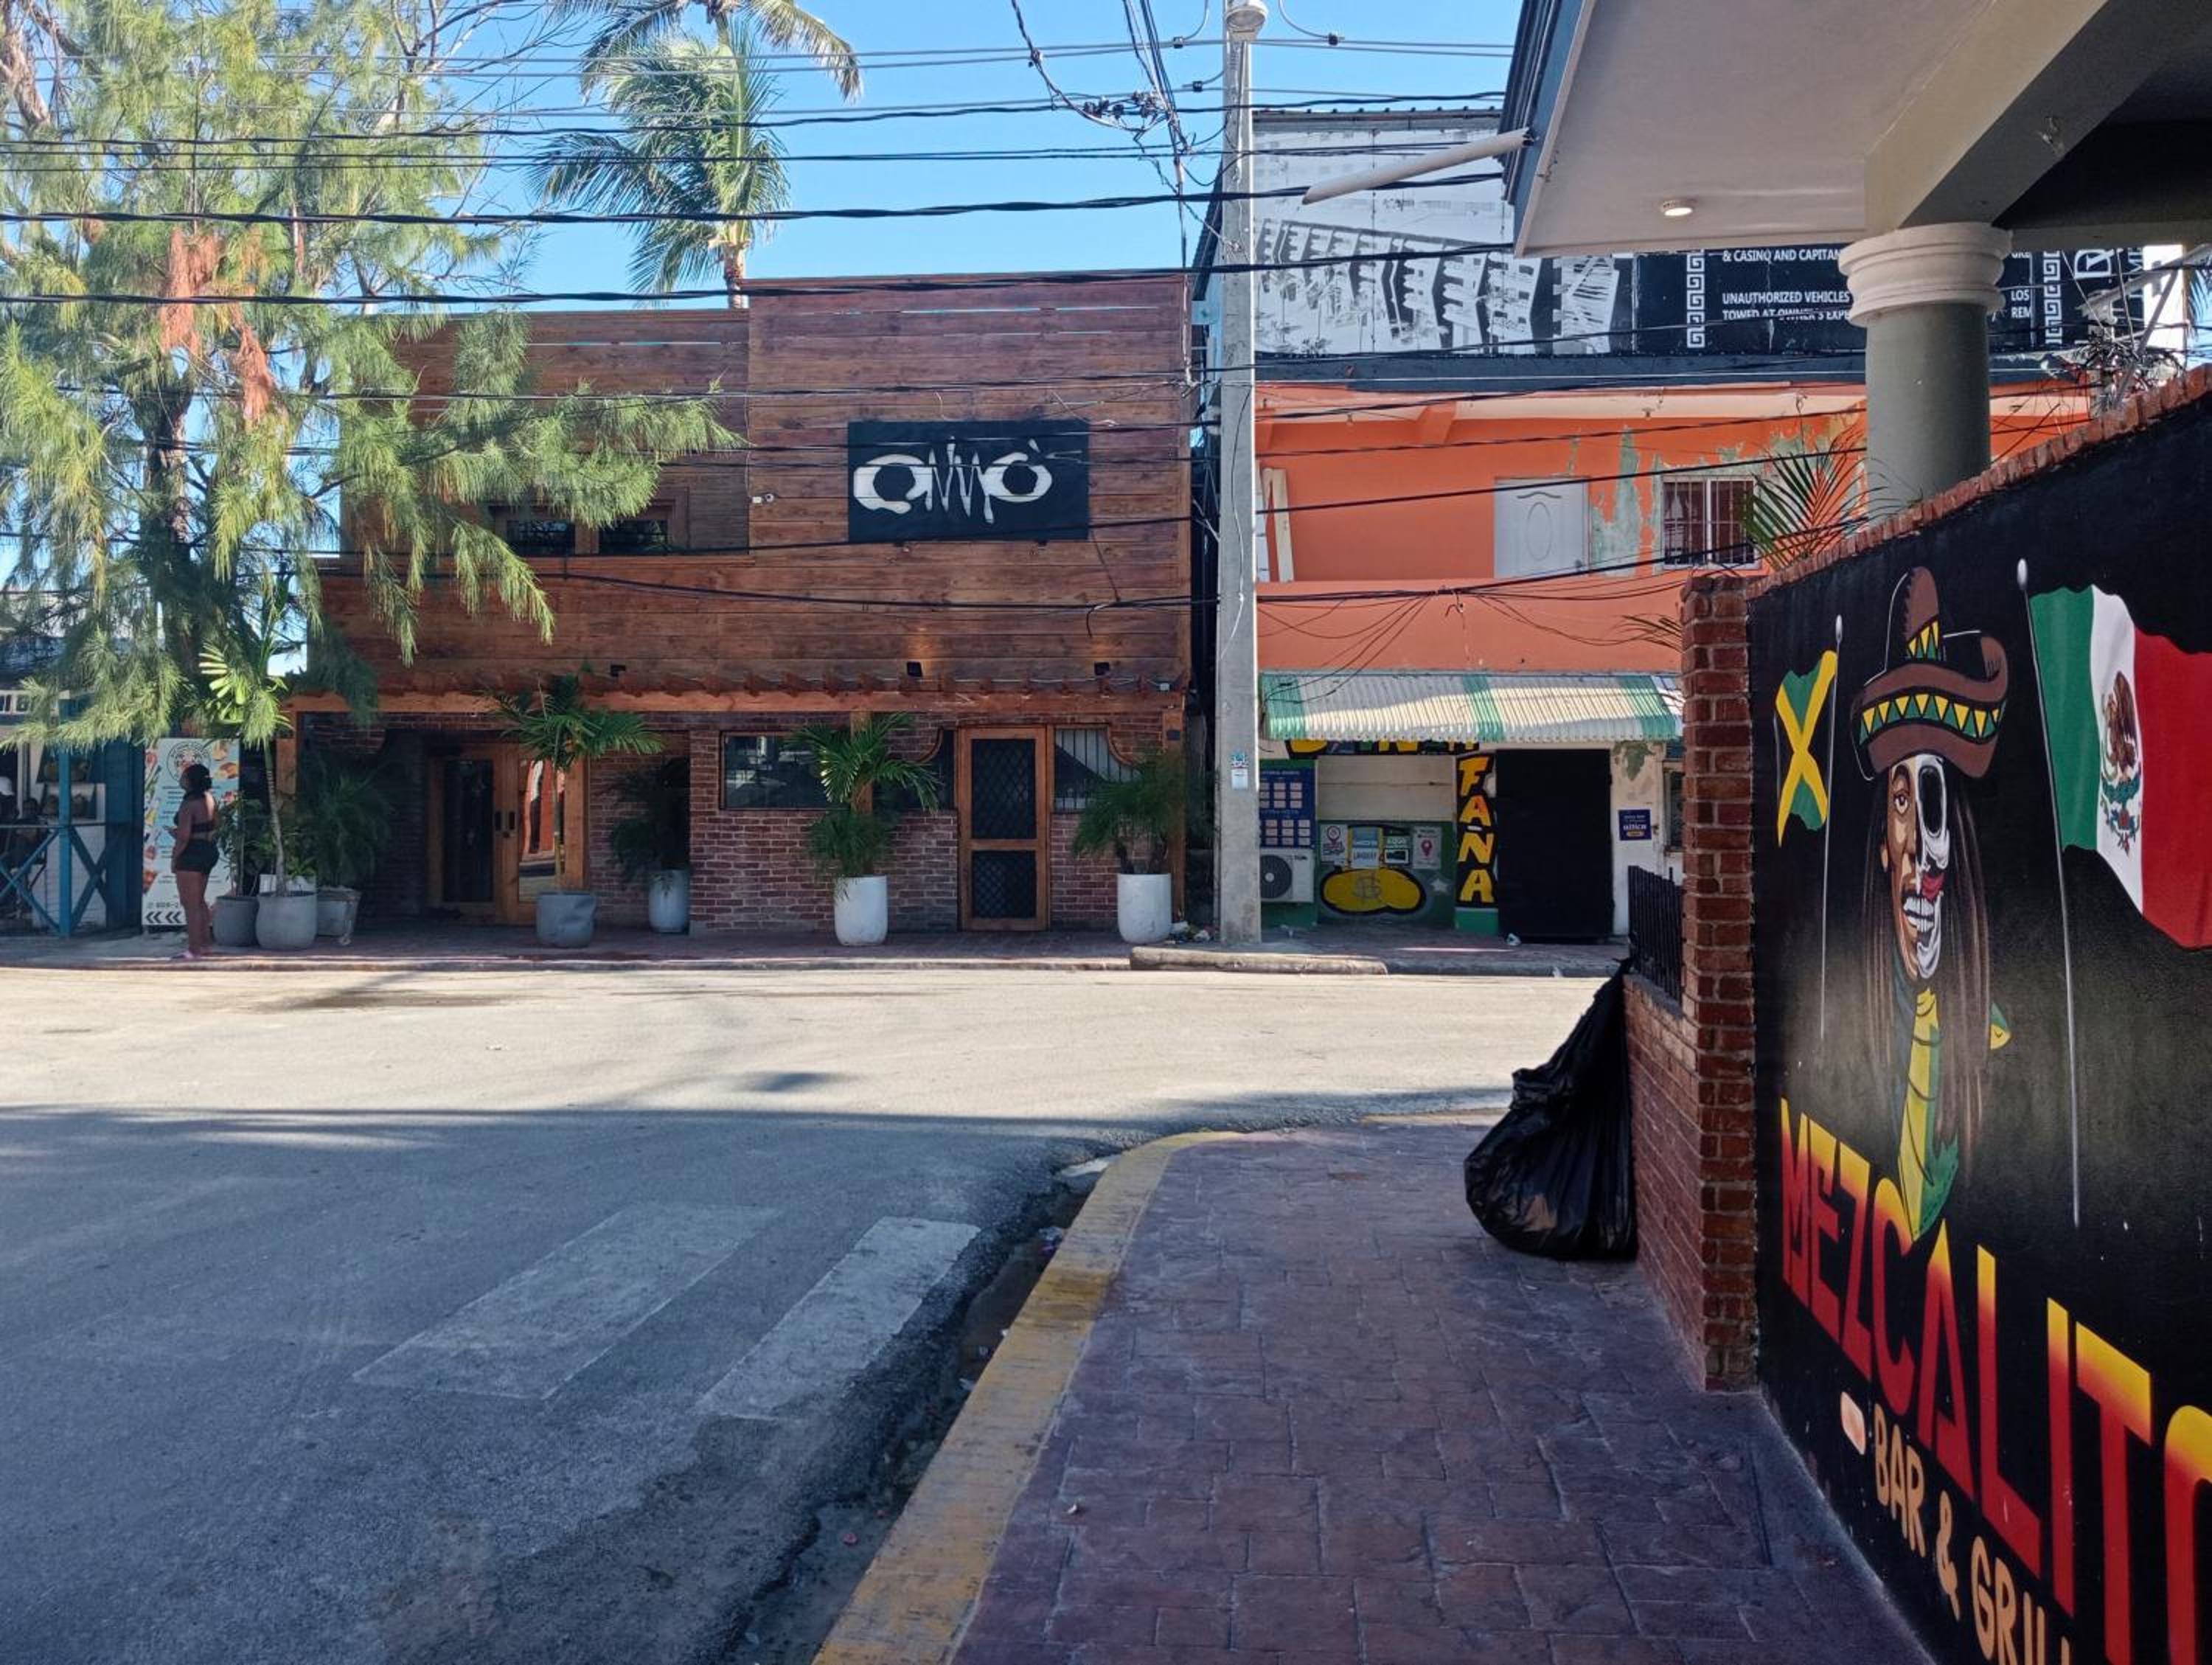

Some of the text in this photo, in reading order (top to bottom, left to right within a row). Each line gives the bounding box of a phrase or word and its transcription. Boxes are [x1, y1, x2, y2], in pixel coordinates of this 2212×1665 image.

[1722, 250, 1732, 262] &
[1733, 249, 1771, 262] CASINO
[1774, 249, 1796, 260] AND
[1722, 291, 1850, 304] UNAUTHORIZED VEHICLES
[2011, 290, 2029, 301] LOS
[1874, 1402, 1926, 1557] BAR
[1936, 1490, 1961, 1621] &
